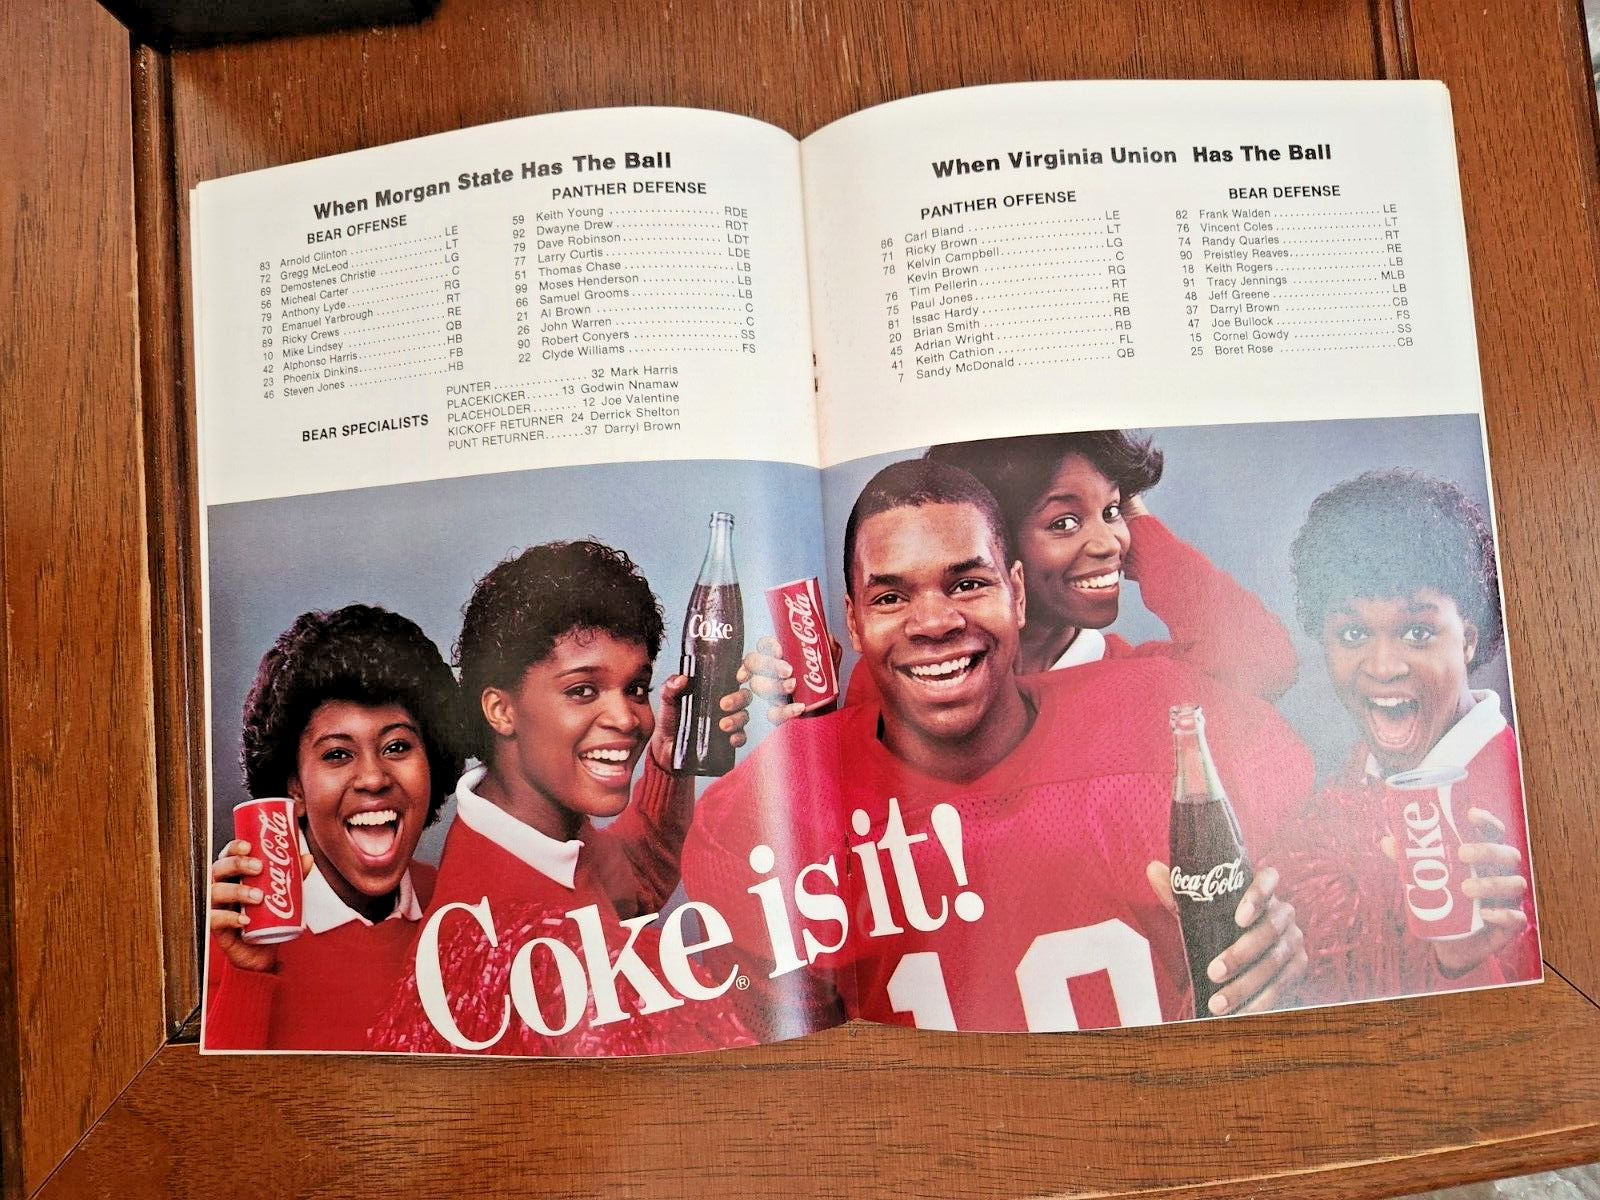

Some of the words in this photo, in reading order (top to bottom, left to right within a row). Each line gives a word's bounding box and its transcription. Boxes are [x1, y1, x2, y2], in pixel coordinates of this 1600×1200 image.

[931, 158, 1000, 179] When
[1007, 148, 1104, 170] Virginia
[1110, 146, 1177, 164] Union
[1192, 146, 1234, 163] Has
[1239, 144, 1282, 162] The
[1288, 143, 1332, 161] Ball
[313, 198, 368, 220] When
[375, 181, 451, 208] Morgan
[457, 168, 514, 191] State
[521, 161, 563, 180] Has
[572, 154, 616, 173] The
[624, 151, 672, 170] Ball
[552, 182, 627, 200] PANTHER
[632, 181, 707, 195] DEFENSE
[1228, 187, 1268, 200] BEAR
[1272, 184, 1341, 199] DEFENSE
[512, 214, 525, 226] 59
[536, 210, 564, 222] Keith
[567, 208, 604, 218] Young
[724, 205, 748, 218] RDE
[920, 197, 998, 220] PANTHER
[1002, 190, 1077, 208] OFFENSE
[1175, 210, 1188, 220] 82
[1199, 209, 1229, 219] Frank
[1231, 208, 1271, 218] Walden
[1383, 203, 1397, 214] LE
[307, 227, 342, 245] BEAR
[346, 214, 408, 237] OFFENSE
[513, 242, 526, 253] 79
[537, 239, 564, 250] Dave
[568, 234, 621, 246] Robinson
[727, 233, 750, 245] LDT
[880, 237, 894, 249] 86
[904, 230, 928, 244] Carl
[931, 224, 964, 238] Bland
[1105, 210, 1120, 220] LE
[1178, 236, 1191, 246] 74
[1202, 236, 1236, 248] Randy
[1238, 235, 1280, 246] Quarles
[1385, 230, 1400, 240] RT
[259, 261, 271, 271] 83
[280, 254, 310, 268] Arnold
[313, 249, 348, 262] Clinton
[445, 225, 459, 236] LE
[883, 264, 896, 276] 78
[907, 256, 941, 271] Kelvin
[945, 246, 999, 263] Campbell
[1106, 237, 1123, 248] LG
[260, 286, 272, 297] 69
[280, 277, 337, 294] Demostenes
[340, 268, 376, 283] Christie
[444, 252, 459, 264] LG
[514, 270, 526, 280] 51
[538, 265, 582, 277] Thomas
[585, 261, 621, 272] Chase
[736, 261, 751, 272] LB
[1182, 264, 1195, 274] 18
[1205, 263, 1233, 274] Keith
[1236, 262, 1273, 274] Rogers
[1388, 256, 1404, 267] LB
[516, 297, 529, 308] 66
[539, 290, 580, 305] Samuel
[584, 289, 630, 300] Grooms
[738, 288, 753, 299] LB
[885, 291, 898, 303] 76
[909, 286, 931, 296] Tim
[934, 278, 978, 293] Pellerin
[1108, 264, 1126, 275] RG
[1184, 291, 1198, 301] 48
[1208, 289, 1228, 301] Jeff
[1231, 289, 1270, 300] Greene
[1392, 283, 1407, 293] LB
[261, 312, 272, 322] 79
[281, 306, 320, 319] Anthony
[323, 300, 346, 314] Lyde
[444, 278, 460, 290] RG
[888, 318, 899, 330] 81
[912, 312, 940, 324] Issac
[944, 305, 979, 319] Hardy
[1112, 292, 1130, 302] RE
[262, 338, 273, 348] 89
[282, 334, 308, 345] Ricky
[310, 329, 340, 341] Crews
[447, 306, 462, 317] RE
[517, 324, 530, 336] 26
[540, 321, 568, 333] John
[571, 318, 612, 329] Warren
[746, 316, 755, 327] C
[1188, 318, 1200, 328] 47
[1211, 318, 1231, 328] Joe
[1234, 316, 1274, 327] Bullock
[1396, 309, 1410, 320] FS
[518, 352, 531, 363] 22
[542, 348, 574, 362] Clyde
[577, 344, 625, 356] Williams
[742, 343, 756, 354] FS
[890, 345, 903, 356] 45
[914, 338, 952, 352] Adrian
[954, 331, 994, 345] Wright
[1115, 320, 1132, 330] RB
[1190, 346, 1204, 356] 25
[1214, 345, 1244, 356] Boret
[1247, 344, 1274, 354] Rose
[1397, 336, 1414, 347] CB
[263, 364, 274, 374] 42
[282, 358, 327, 372] Alphonso
[329, 352, 358, 364] Harris
[447, 333, 463, 345] HB
[898, 373, 904, 383] 7
[916, 365, 952, 380] Sandy
[956, 356, 1015, 373] McDonald
[1116, 347, 1135, 358] QB
[264, 390, 275, 399] 46
[283, 386, 314, 397] Steven
[317, 381, 345, 392] Jones
[448, 360, 464, 372] HB
[446, 380, 491, 396] PUNTER
[591, 368, 605, 379] 32
[610, 366, 640, 377] Mark
[643, 364, 678, 375] Harris
[447, 390, 526, 410] PLACEKICKER
[562, 384, 575, 395] 13
[580, 381, 624, 394] Godwin
[628, 380, 679, 390] Nnamaw
[447, 403, 531, 423] PLACEHOLDER
[582, 396, 596, 407] 12
[601, 396, 622, 406] Joe
[625, 392, 680, 404] Valentine
[302, 426, 337, 442] BEAR
[342, 413, 429, 437] SPECIALISTS
[448, 421, 496, 436] KICKOFF
[500, 414, 564, 430] RETURNER
[571, 412, 584, 423] 24
[590, 408, 632, 421] Derrick
[636, 406, 680, 418] Shelton
[448, 437, 478, 450] PUNT
[482, 430, 545, 446] RETURNER
[584, 424, 598, 436] 37
[604, 422, 639, 434] Darryl
[643, 421, 681, 432] Brown
[688, 613, 733, 642] Coke
[258, 808, 294, 919] Coca-Cola
[1403, 801, 1454, 922] Coke
[415, 895, 742, 1050] Coke
[748, 844, 850, 978] is
[850, 797, 985, 937] it!
